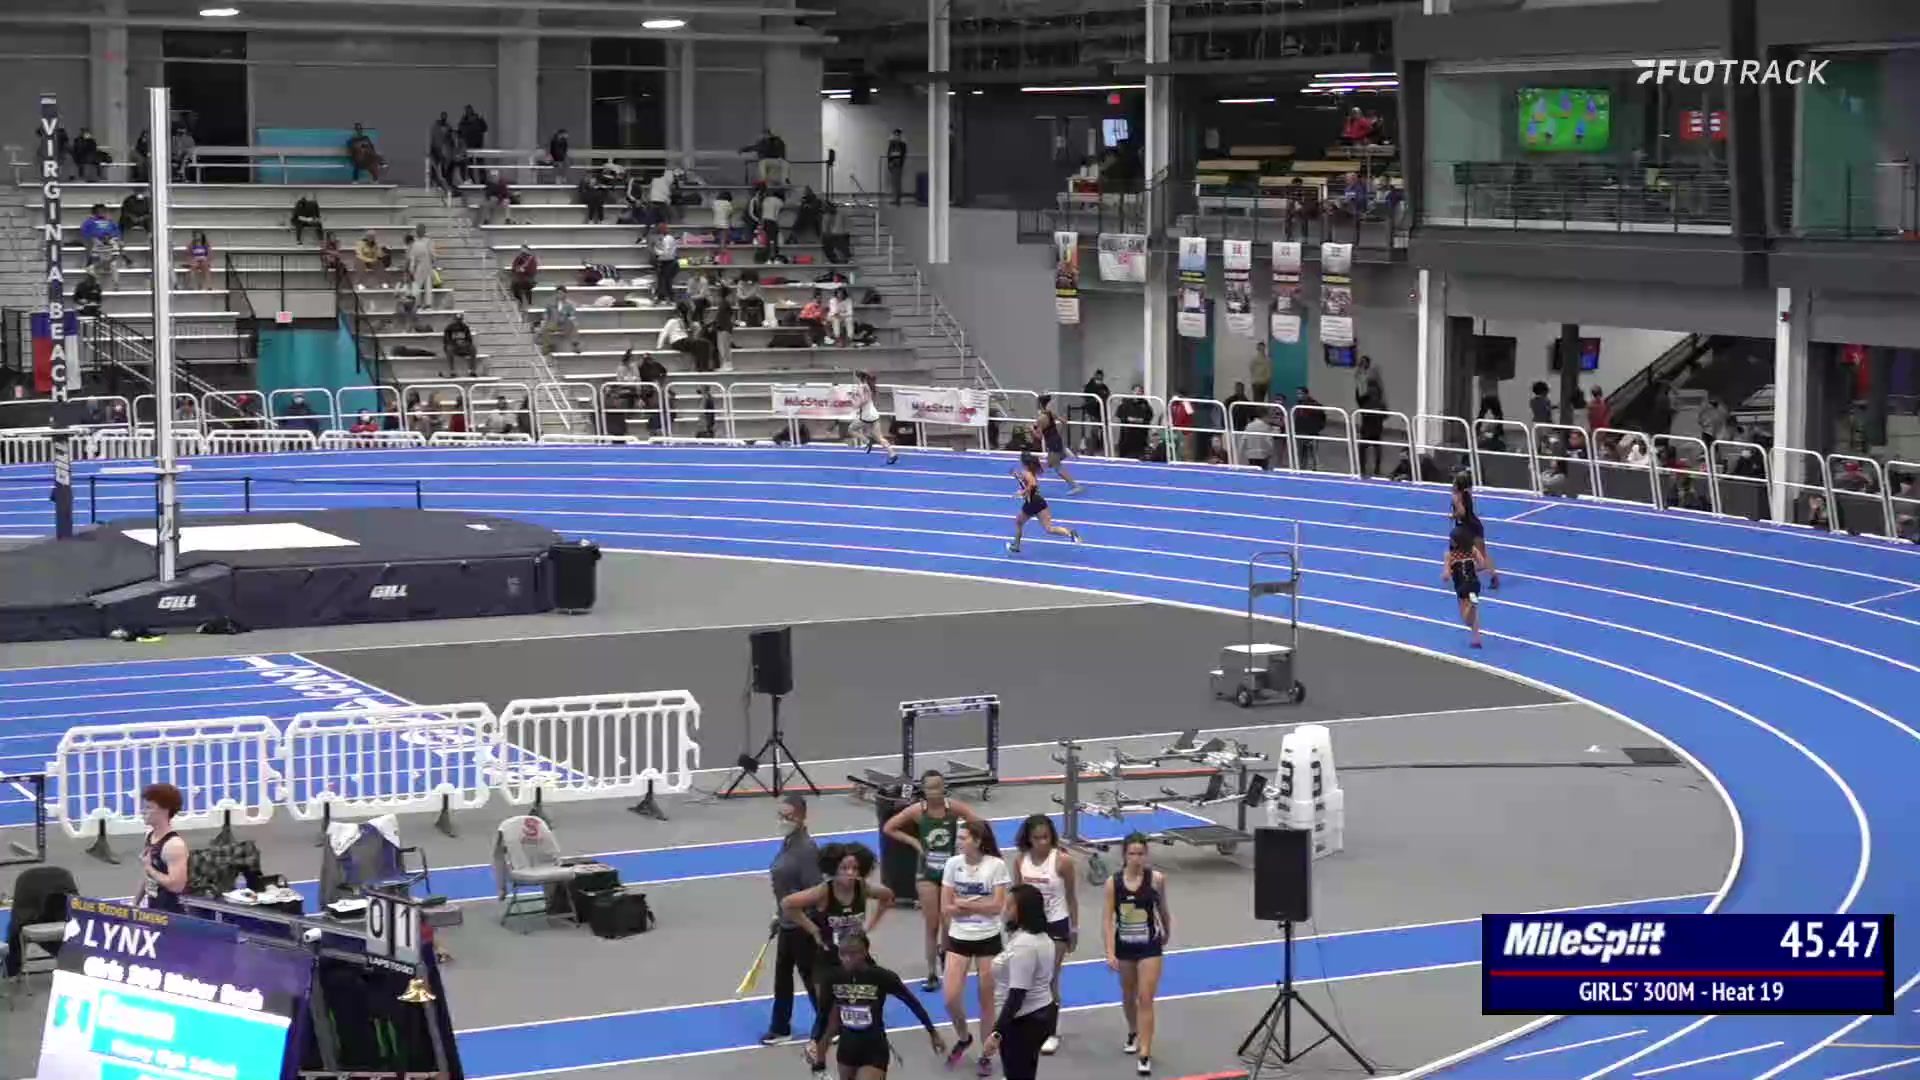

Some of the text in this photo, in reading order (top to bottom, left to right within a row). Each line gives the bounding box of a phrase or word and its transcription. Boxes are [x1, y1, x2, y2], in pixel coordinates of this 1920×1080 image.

[40, 118, 68, 402] VIRGINIA BEACH
[158, 594, 197, 609] GILL
[370, 584, 409, 598] GILL
[82, 918, 161, 960] LYNX
